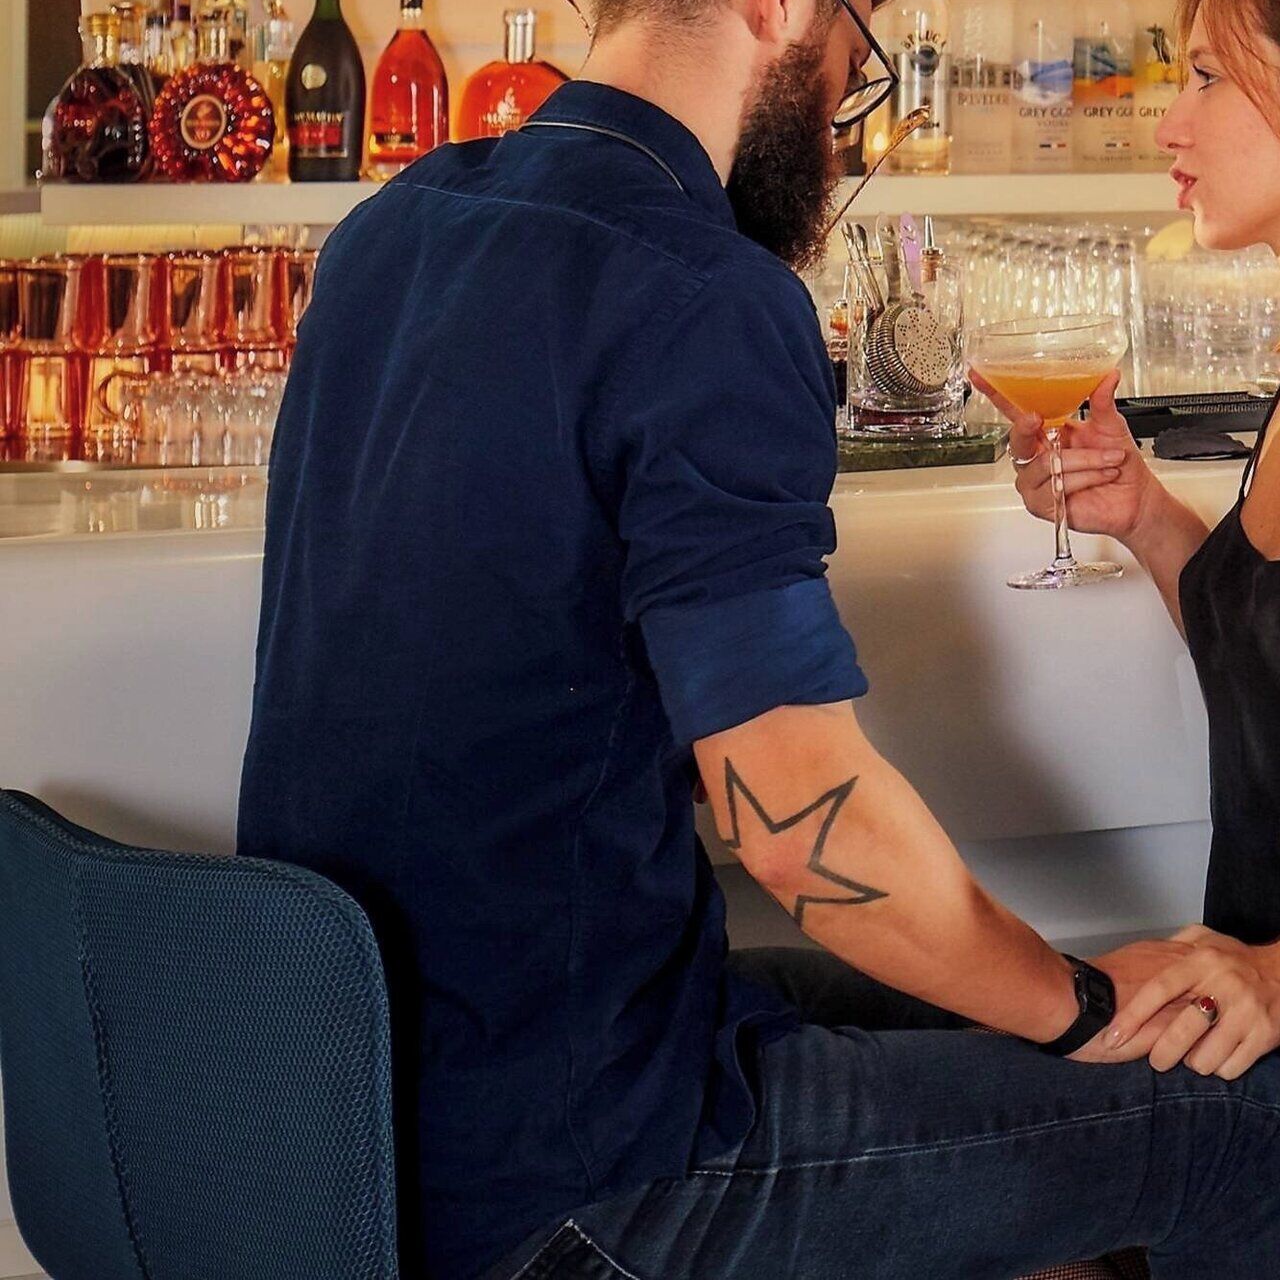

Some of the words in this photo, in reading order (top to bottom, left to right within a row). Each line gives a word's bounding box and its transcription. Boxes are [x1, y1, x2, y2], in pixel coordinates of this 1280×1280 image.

[1019, 107, 1047, 118] GREY
[1083, 107, 1113, 118] GREY
[1138, 107, 1168, 118] GREY
